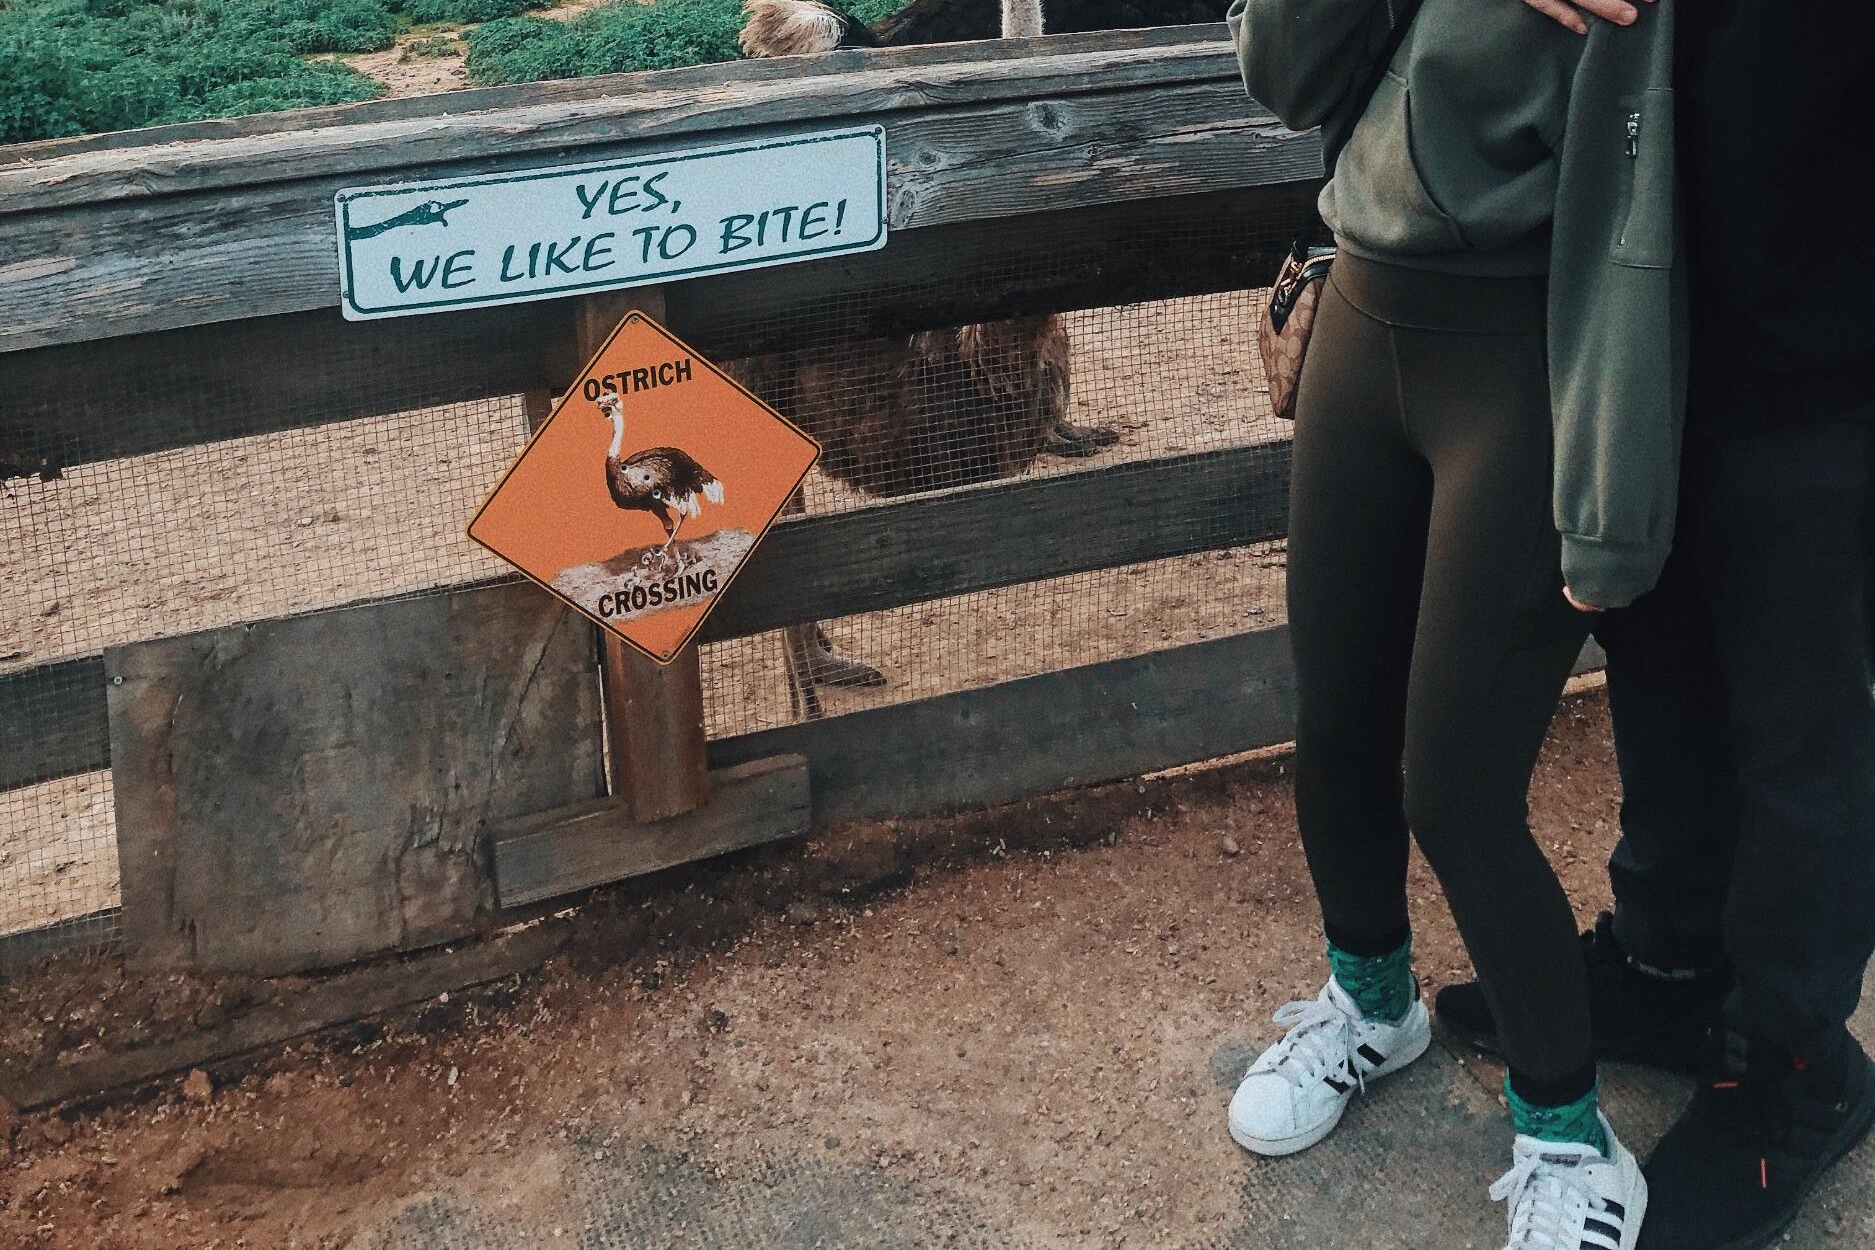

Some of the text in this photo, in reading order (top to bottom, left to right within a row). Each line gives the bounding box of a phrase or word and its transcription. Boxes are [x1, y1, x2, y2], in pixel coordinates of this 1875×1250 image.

[576, 172, 683, 219] YES,
[390, 200, 847, 294] WE LIKE TO BITE!
[583, 358, 692, 401] OSTRICH
[598, 569, 718, 618] CROSSING
